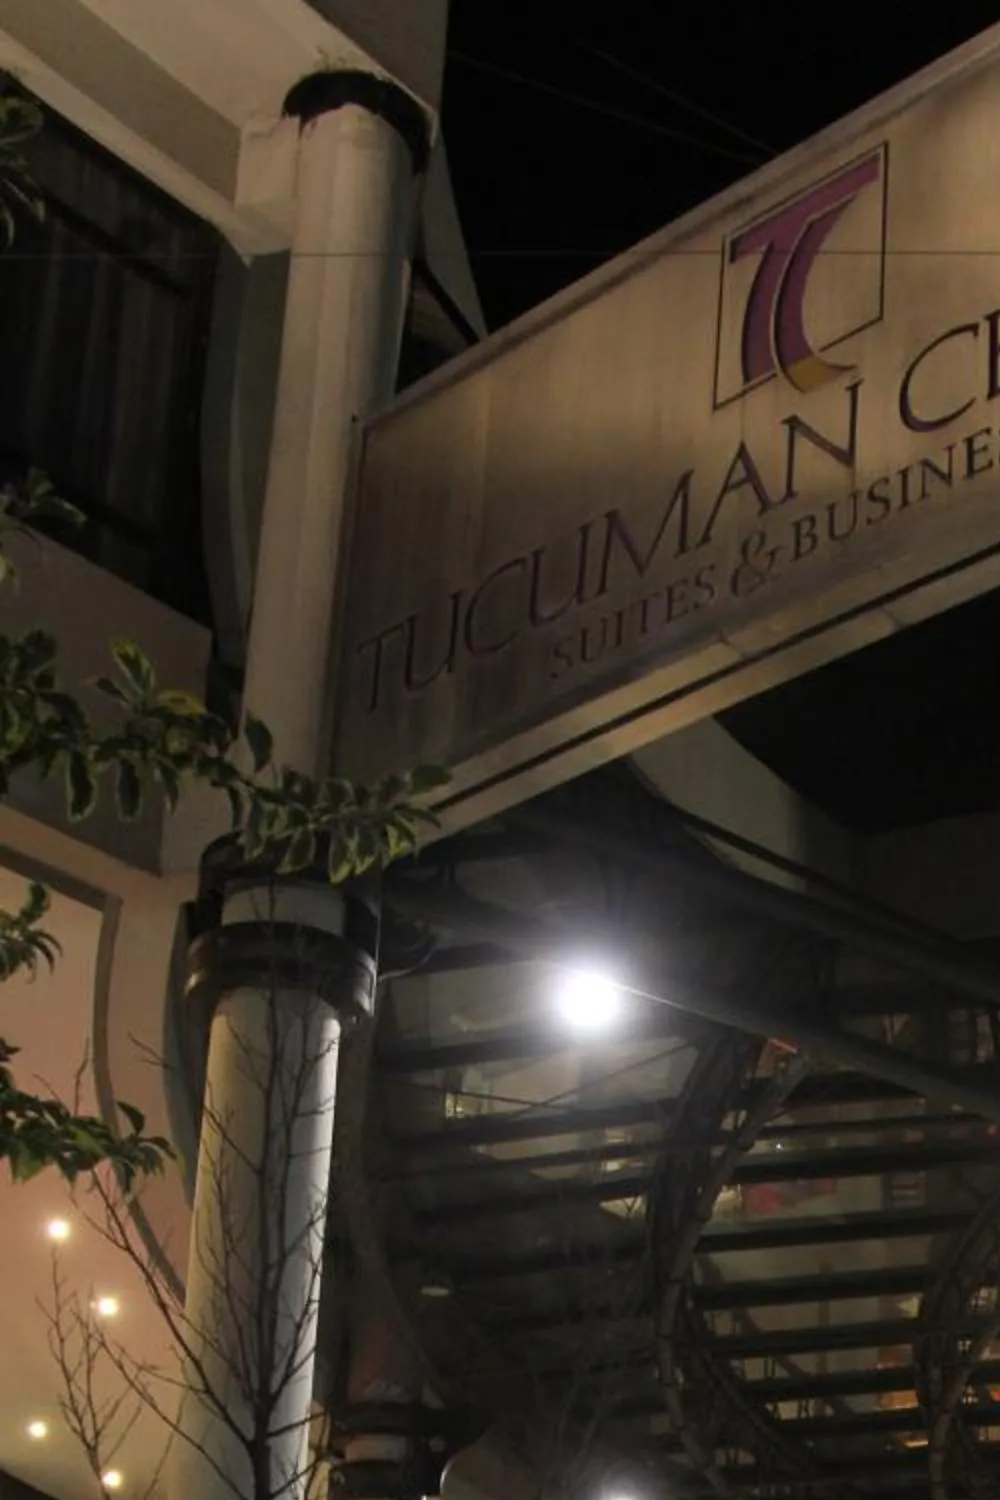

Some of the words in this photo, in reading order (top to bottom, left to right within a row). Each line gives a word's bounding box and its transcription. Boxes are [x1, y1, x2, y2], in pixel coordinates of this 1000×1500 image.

[356, 378, 864, 714] TUCUMAN
[551, 563, 716, 679] SUITES
[728, 530, 783, 594] &
